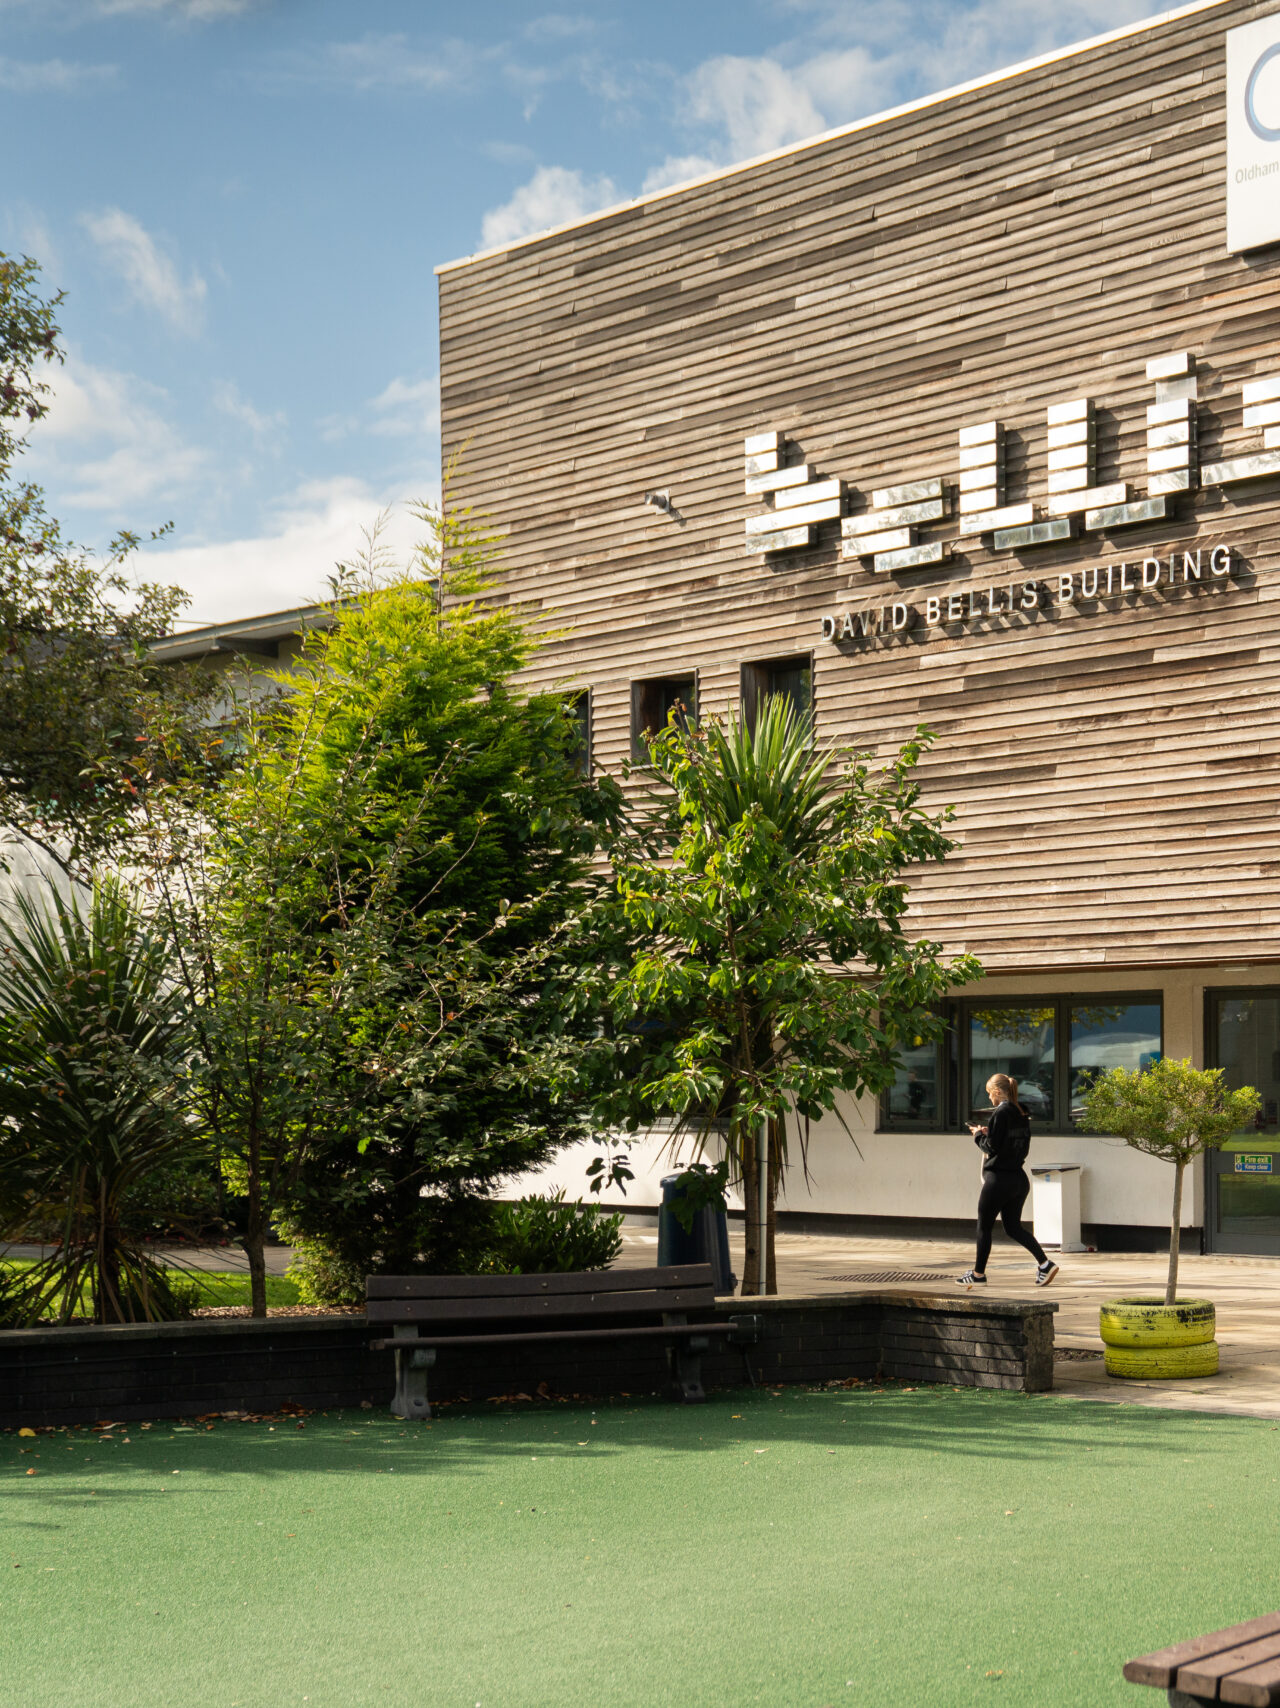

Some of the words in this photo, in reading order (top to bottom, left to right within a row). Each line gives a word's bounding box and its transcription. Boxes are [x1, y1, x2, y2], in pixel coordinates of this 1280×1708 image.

[1235, 161, 1279, 184] Oldham
[821, 603, 908, 641] DAVID
[926, 580, 1038, 624] BELLIS
[1058, 544, 1231, 602] BUILDING
